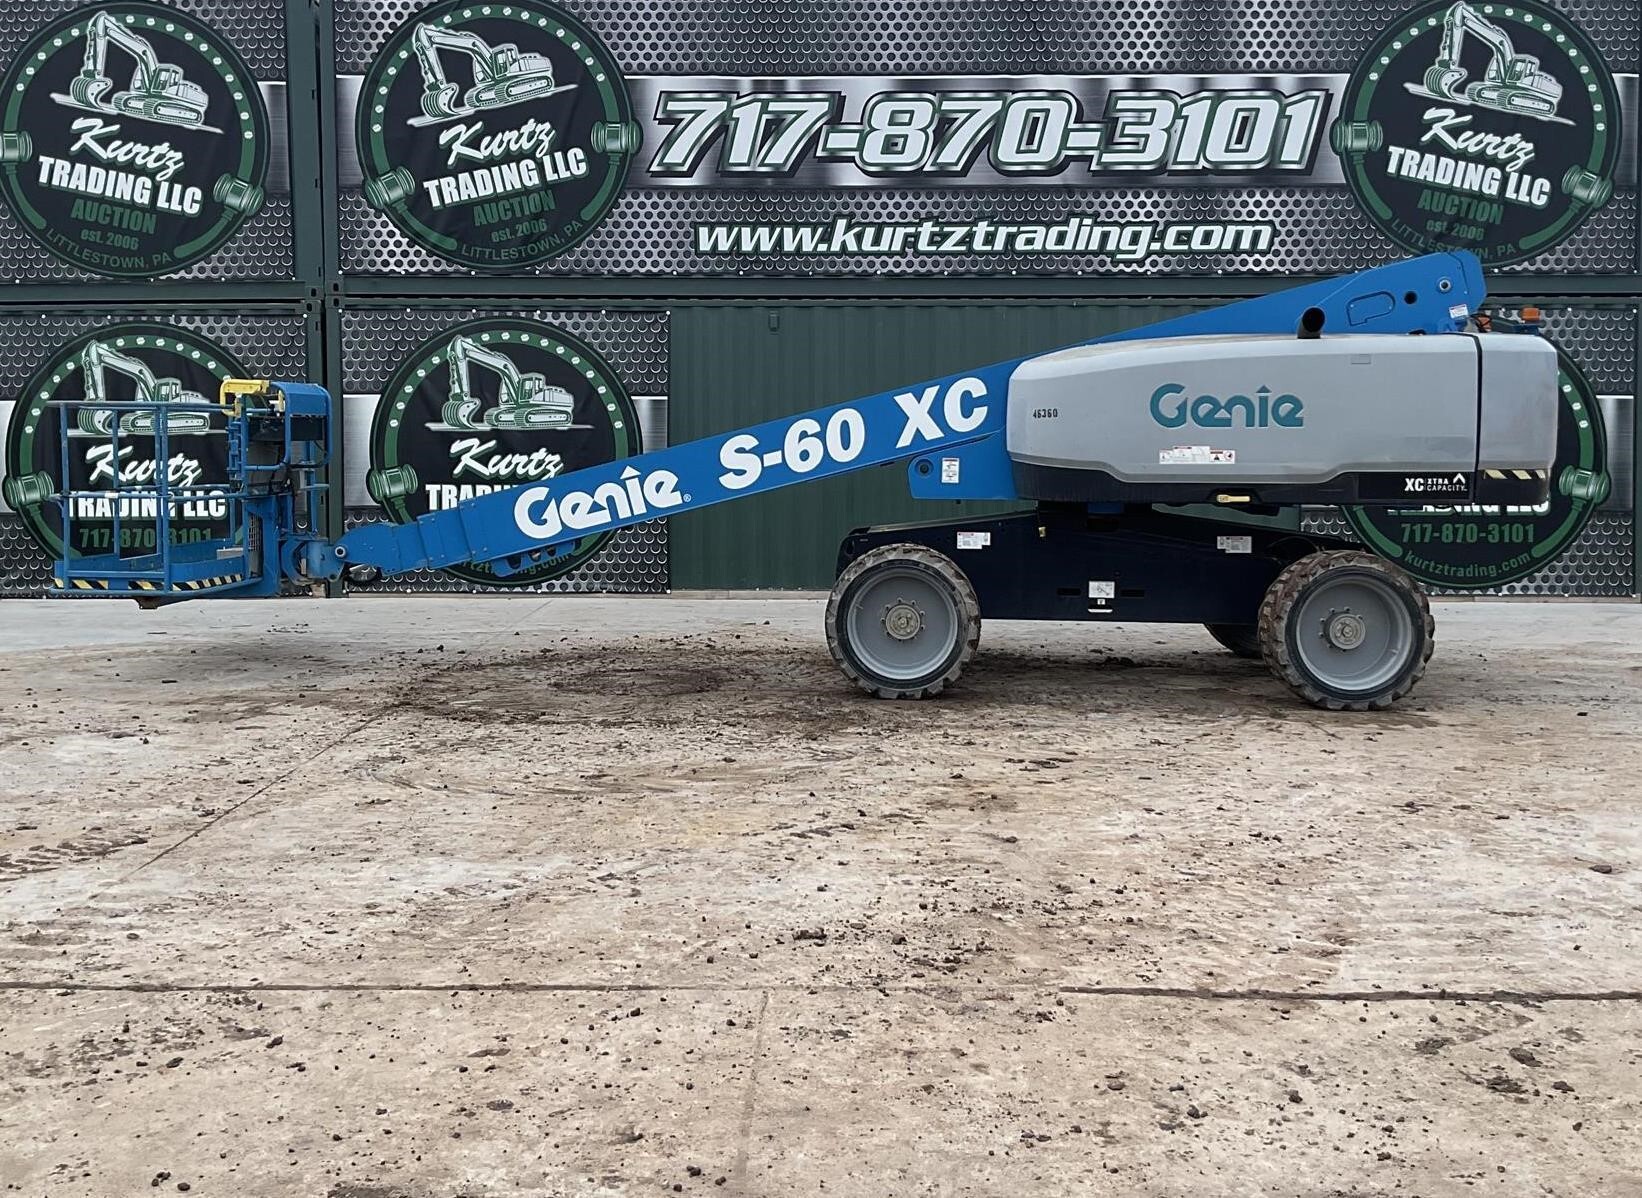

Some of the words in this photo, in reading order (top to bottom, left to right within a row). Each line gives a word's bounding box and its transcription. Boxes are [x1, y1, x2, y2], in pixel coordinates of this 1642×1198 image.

[71, 117, 184, 180] Kurtz
[439, 118, 555, 165] Kurtz
[651, 92, 1327, 173] 717-870-3101
[1421, 107, 1535, 172] Kurtz
[38, 155, 152, 207] TRADING
[156, 181, 202, 214] LLC
[423, 159, 540, 208] TRADING
[543, 147, 587, 182] LLC
[1387, 146, 1501, 196] TRADING
[1505, 172, 1551, 206] LLC
[70, 199, 157, 234] AUCTION
[473, 189, 556, 226] AUCTION
[1417, 189, 1504, 224] AUCTION
[106, 232, 139, 251] 2006
[516, 219, 548, 238] 2006
[564, 219, 584, 237] PA
[697, 217, 1275, 262] www.kurtztrading.com
[152, 252, 172, 267] PA
[1497, 243, 1516, 257] PA
[1032, 408, 1058, 419] 46360
[1150, 383, 1304, 428] Genie
[86, 443, 201, 487] Kutz
[451, 438, 564, 478] Kurtz
[514, 465, 684, 539] Genie
[718, 408, 865, 490] S-60
[893, 377, 989, 449] XC
[183, 490, 226, 517] LLC
[1404, 478, 1424, 492] XC
[1401, 523, 1534, 543] 717-870-3101
[1404, 550, 1530, 577] kurtztrading.com
